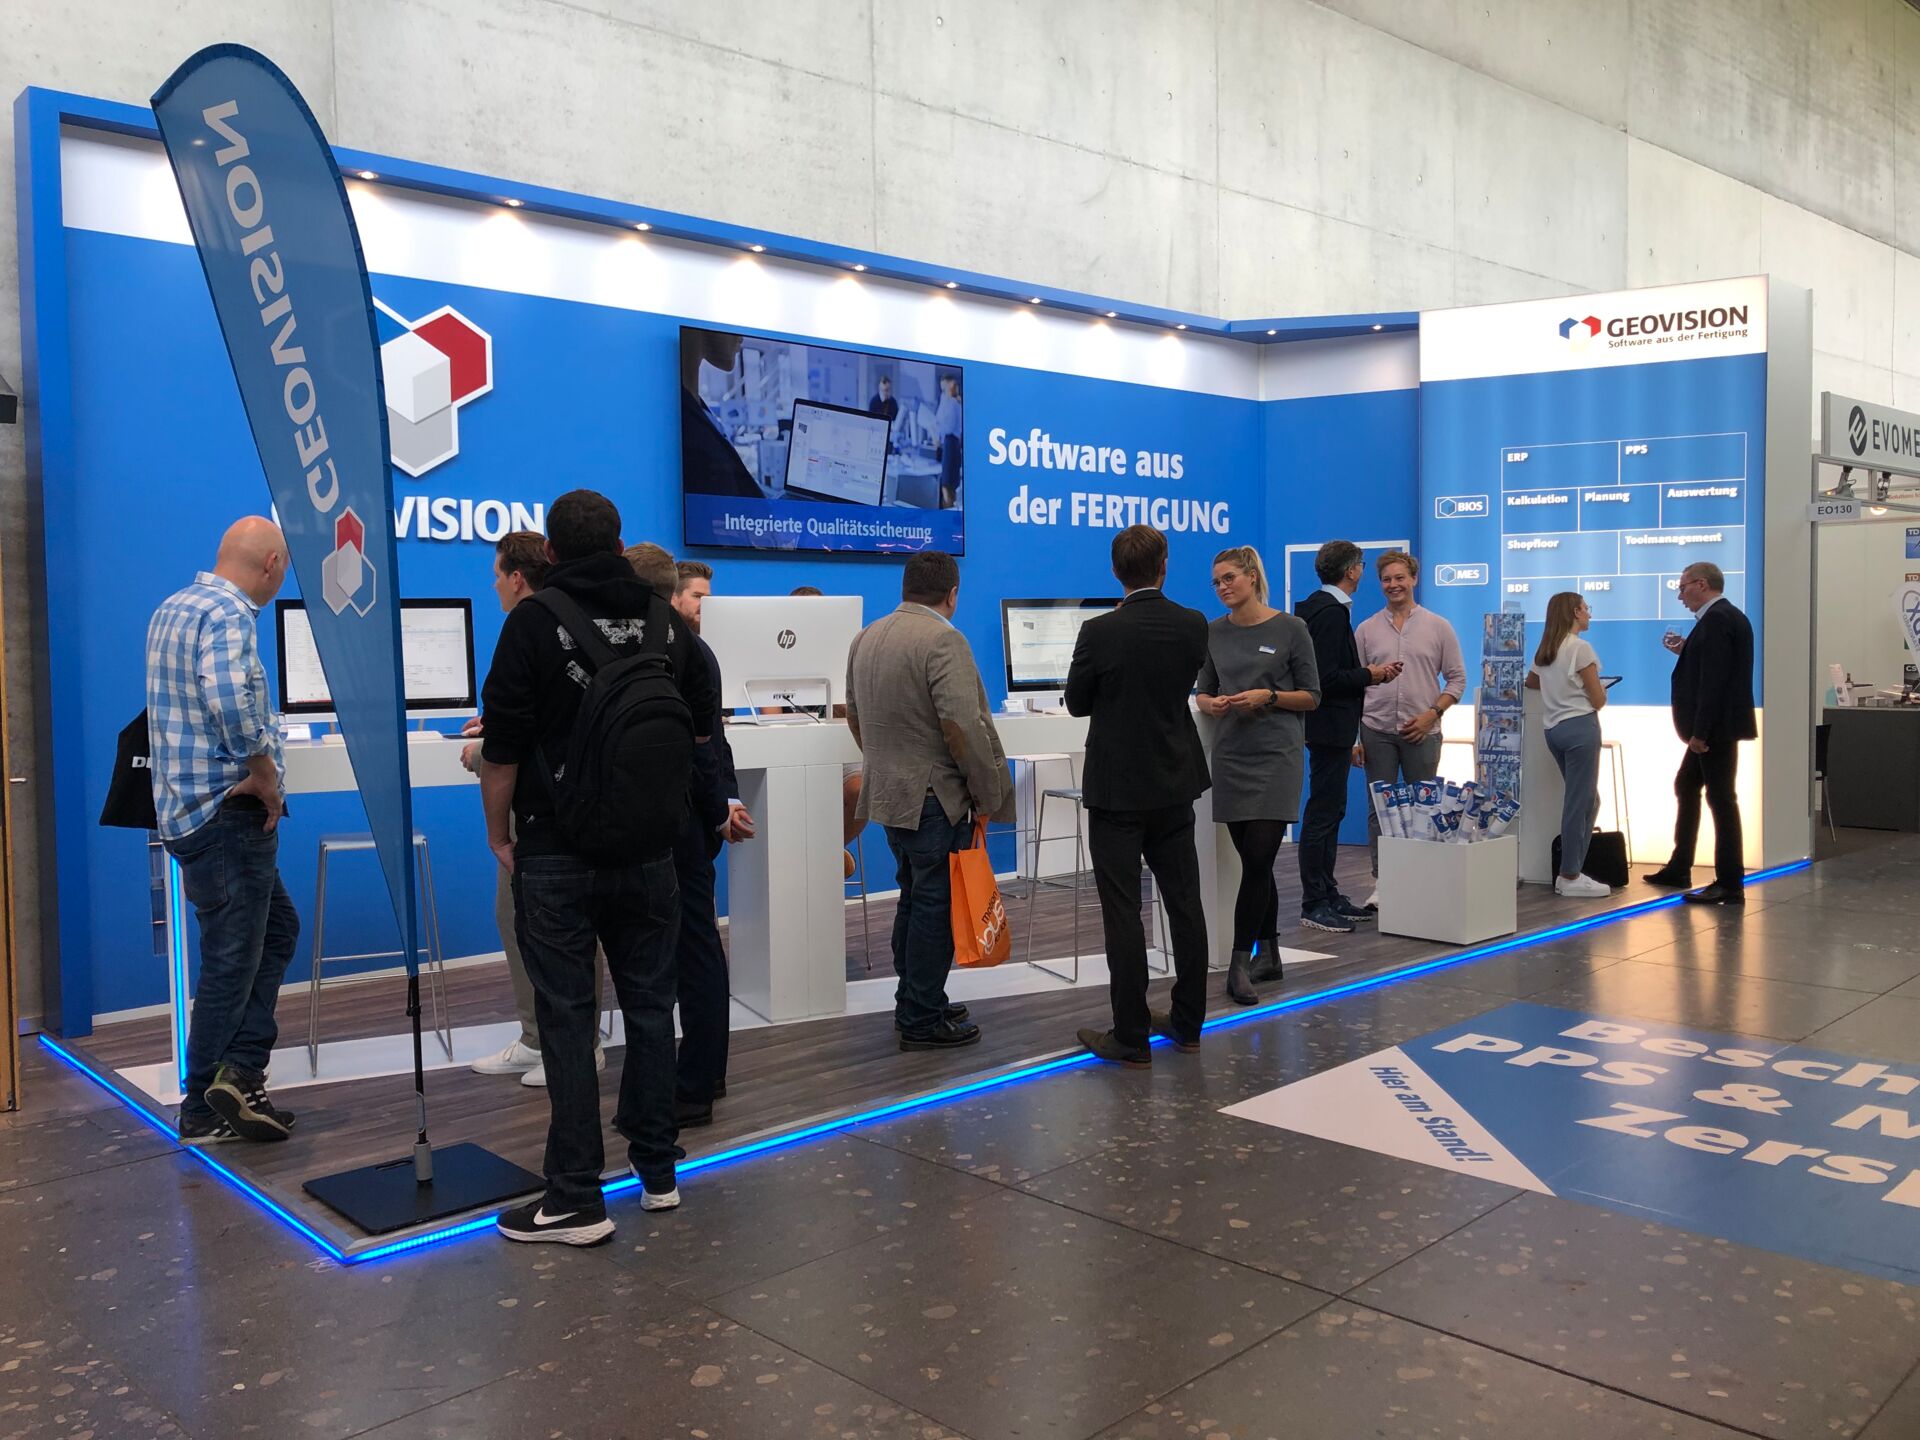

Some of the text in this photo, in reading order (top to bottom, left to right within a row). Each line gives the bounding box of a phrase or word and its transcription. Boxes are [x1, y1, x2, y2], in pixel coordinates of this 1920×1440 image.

[1606, 305, 1749, 338] GEOVISION
[1608, 328, 1749, 349] Software aus der Fertigung
[988, 427, 1185, 480] Software aus
[1625, 444, 1648, 456] PPS
[1507, 452, 1528, 462] ERP
[1584, 491, 1629, 503] Planung
[1667, 486, 1737, 498] Auswertung
[1507, 494, 1567, 506] Kalkulation
[1008, 484, 1230, 534] der FERTIGUNG
[1457, 501, 1483, 513] BIOS
[1817, 504, 1853, 515] EO130
[724, 512, 932, 543] Integrierte Qualitätssicherung
[1625, 532, 1722, 545] Toolmanagement
[1507, 539, 1558, 551] Shopfloor
[1457, 568, 1480, 580] MES
[1507, 583, 1528, 593] BDE
[1584, 581, 1610, 591] MDE
[778, 629, 797, 650] hp
[1478, 754, 1521, 764] ERP/PPS
[1558, 1019, 1920, 1096] Besch
[1431, 1032, 1670, 1086] PPS
[1692, 1083, 1794, 1116] &
[1368, 1066, 1495, 1162] Hier am Stand!
